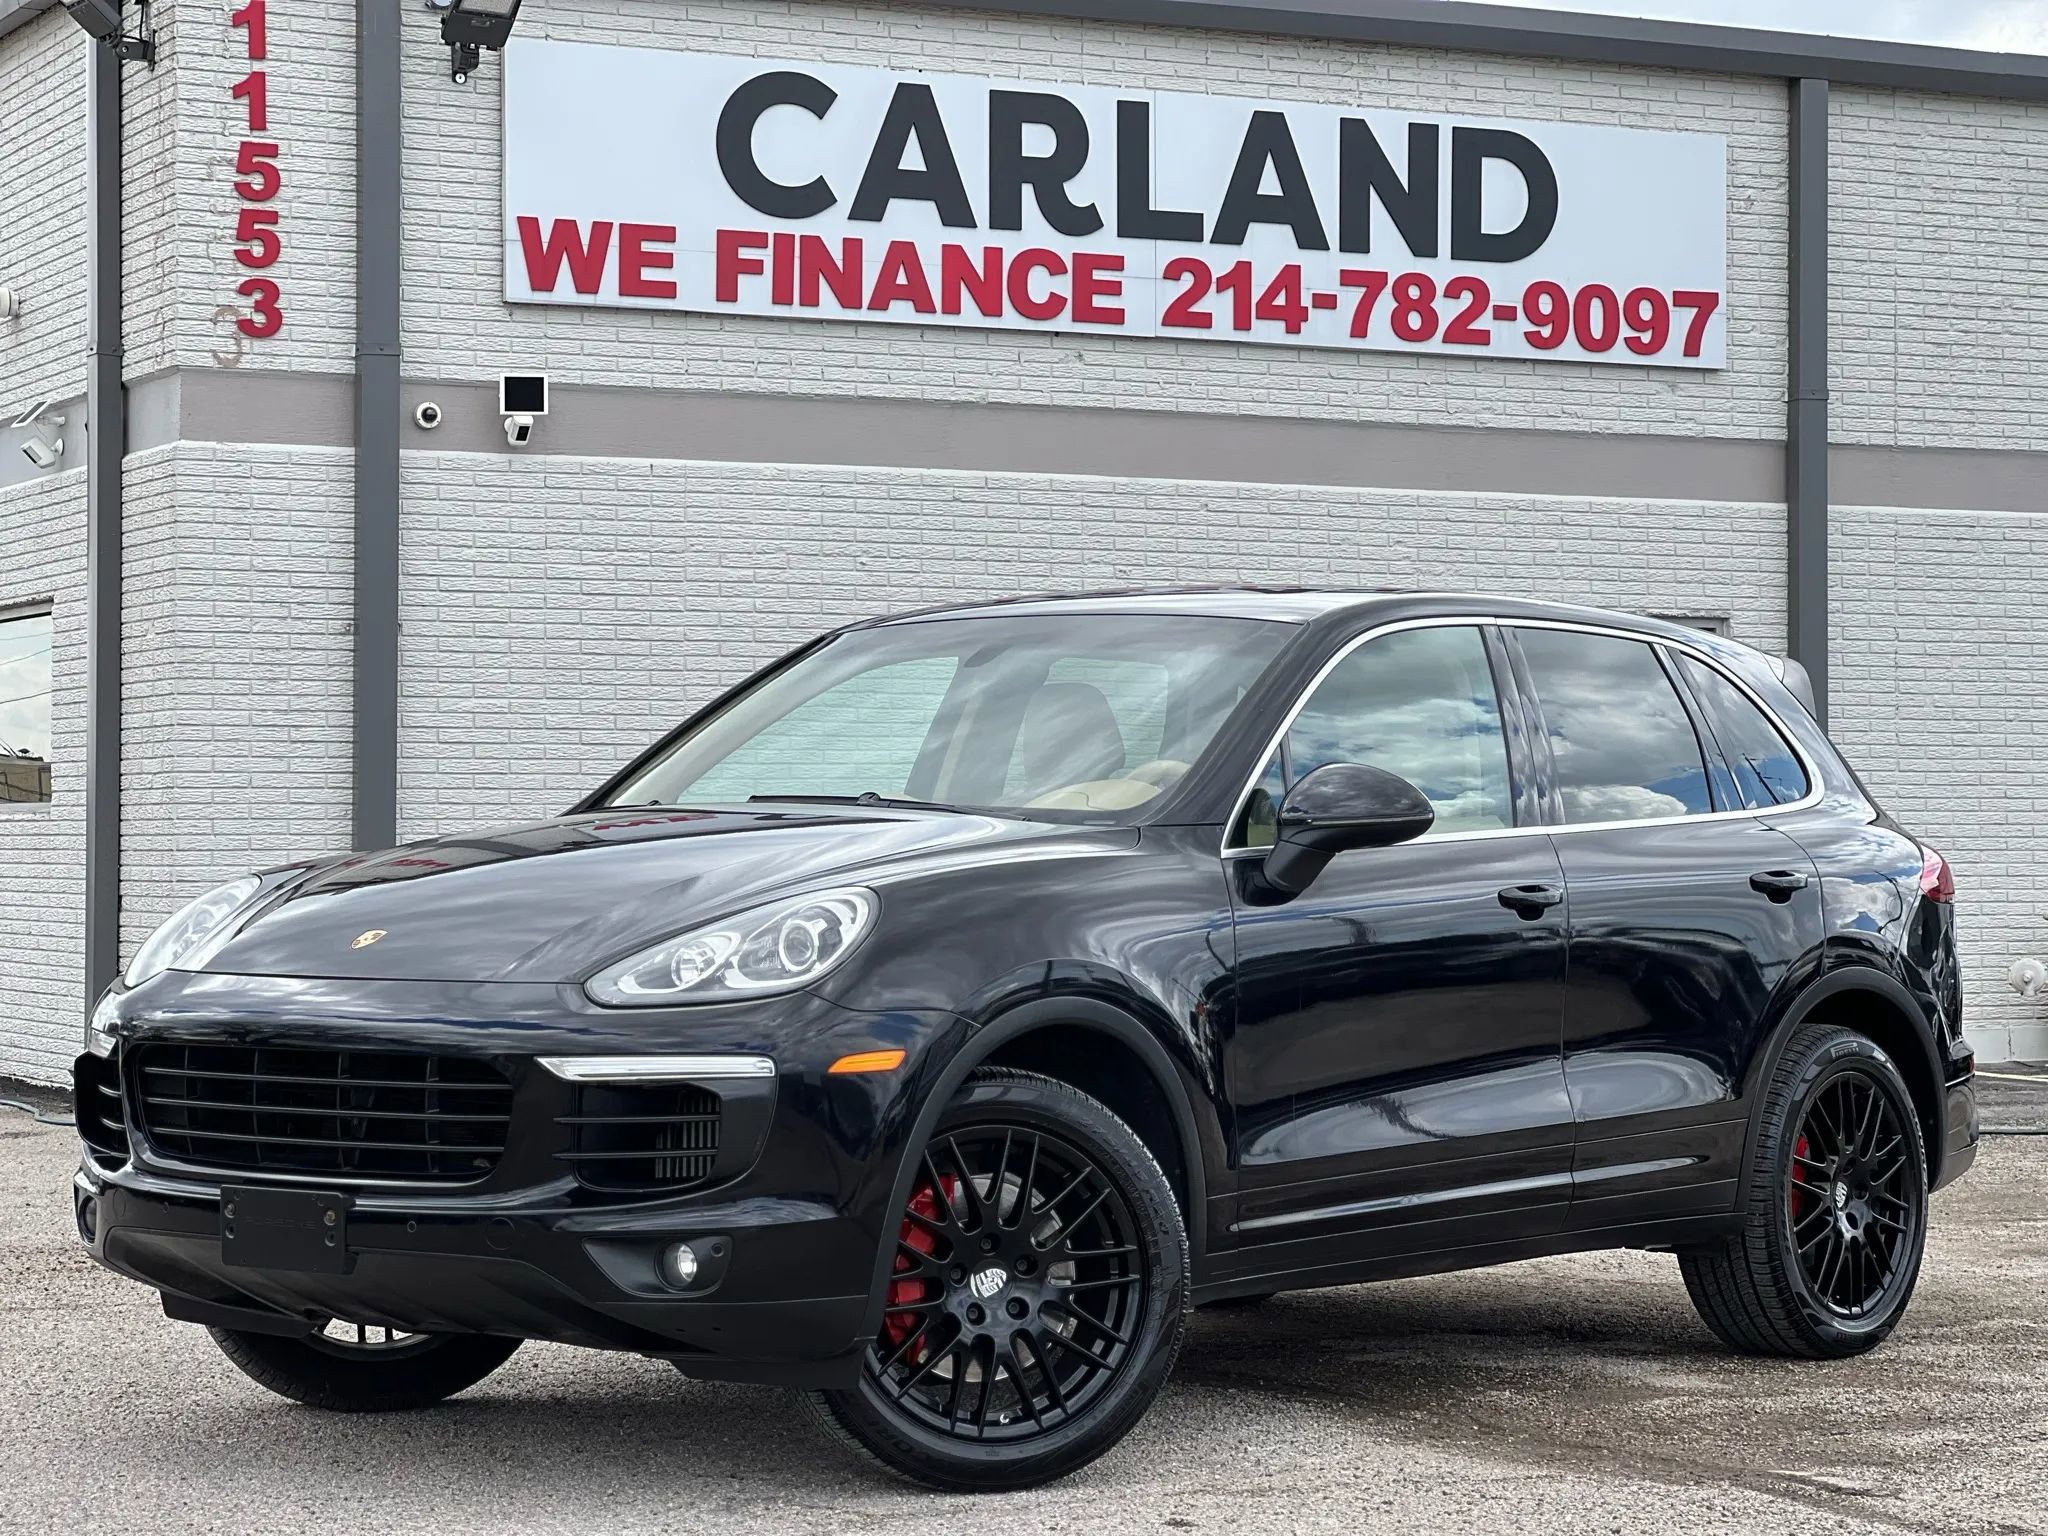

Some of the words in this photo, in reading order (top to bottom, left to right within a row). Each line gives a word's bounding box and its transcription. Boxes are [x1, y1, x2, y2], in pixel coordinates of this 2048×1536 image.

[233, 0, 282, 337] 11553
[716, 71, 1559, 263] CARLAND
[518, 217, 676, 297] WE
[717, 230, 1124, 324] FINANCE
[1163, 258, 1718, 355] 214-782-9097
